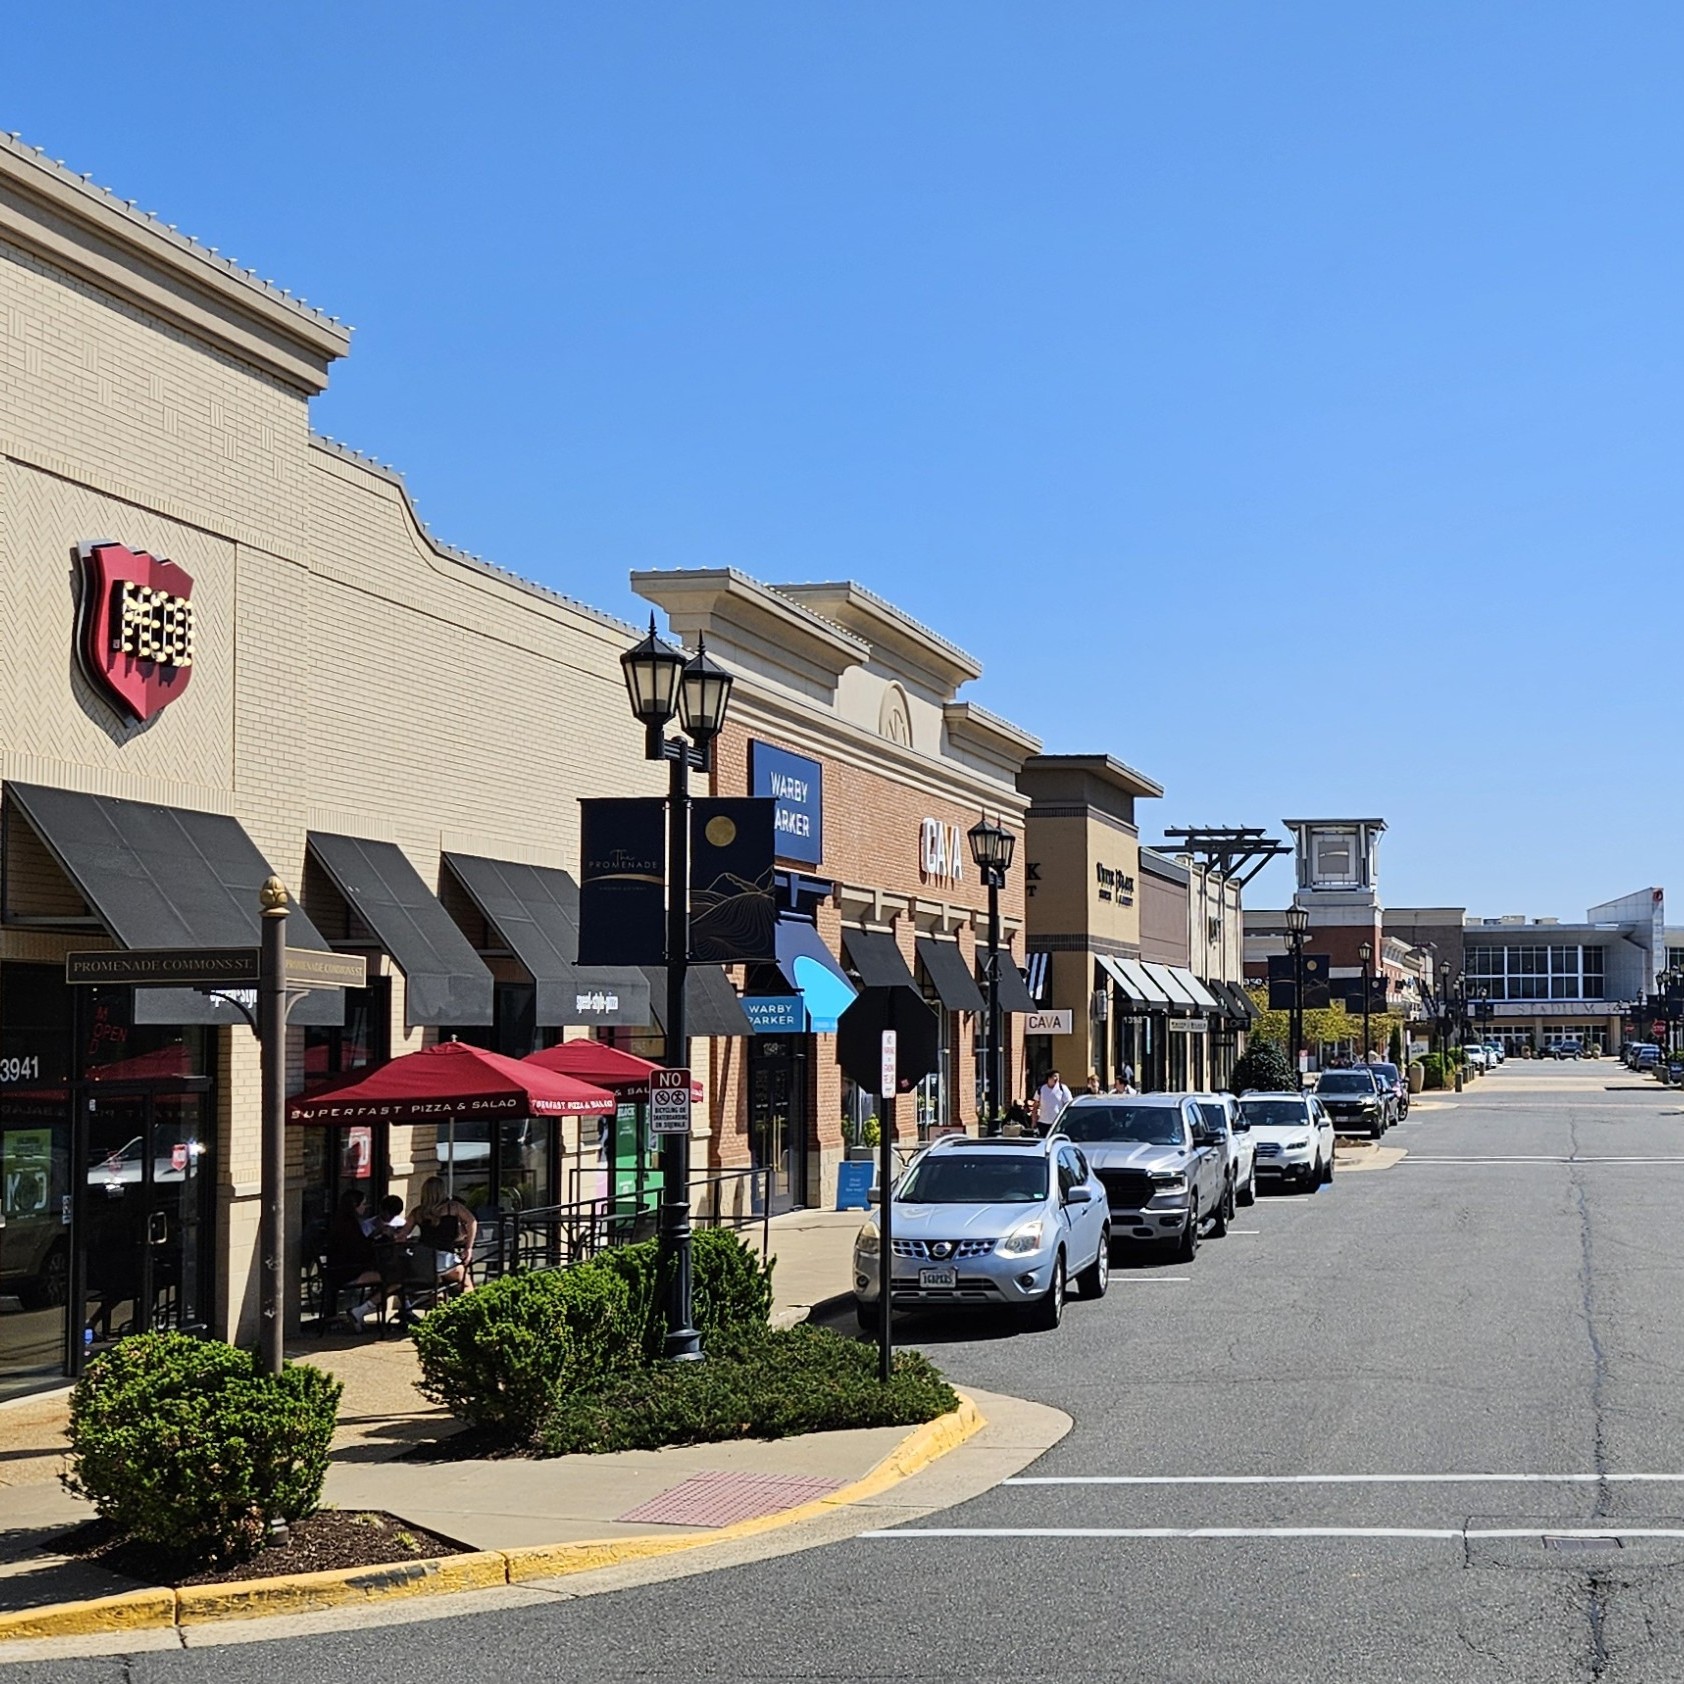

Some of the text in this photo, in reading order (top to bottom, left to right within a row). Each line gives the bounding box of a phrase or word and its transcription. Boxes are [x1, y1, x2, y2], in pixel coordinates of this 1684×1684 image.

[121, 581, 196, 667] MOD
[770, 771, 808, 803] WARBY
[774, 807, 810, 838] ARKER
[920, 816, 963, 880] CAVA
[588, 861, 657, 869] PROMENADE
[73, 958, 253, 973] PROMENADE COMMONS ST.
[749, 1004, 793, 1014] WARBY
[1029, 1016, 1062, 1029] CAVA
[94, 1023, 128, 1042] OPEN
[660, 1072, 682, 1087] NO
[628, 1086, 650, 1097] SAL
[291, 1099, 517, 1119] SUPERFAST PIZZA & SALAD
